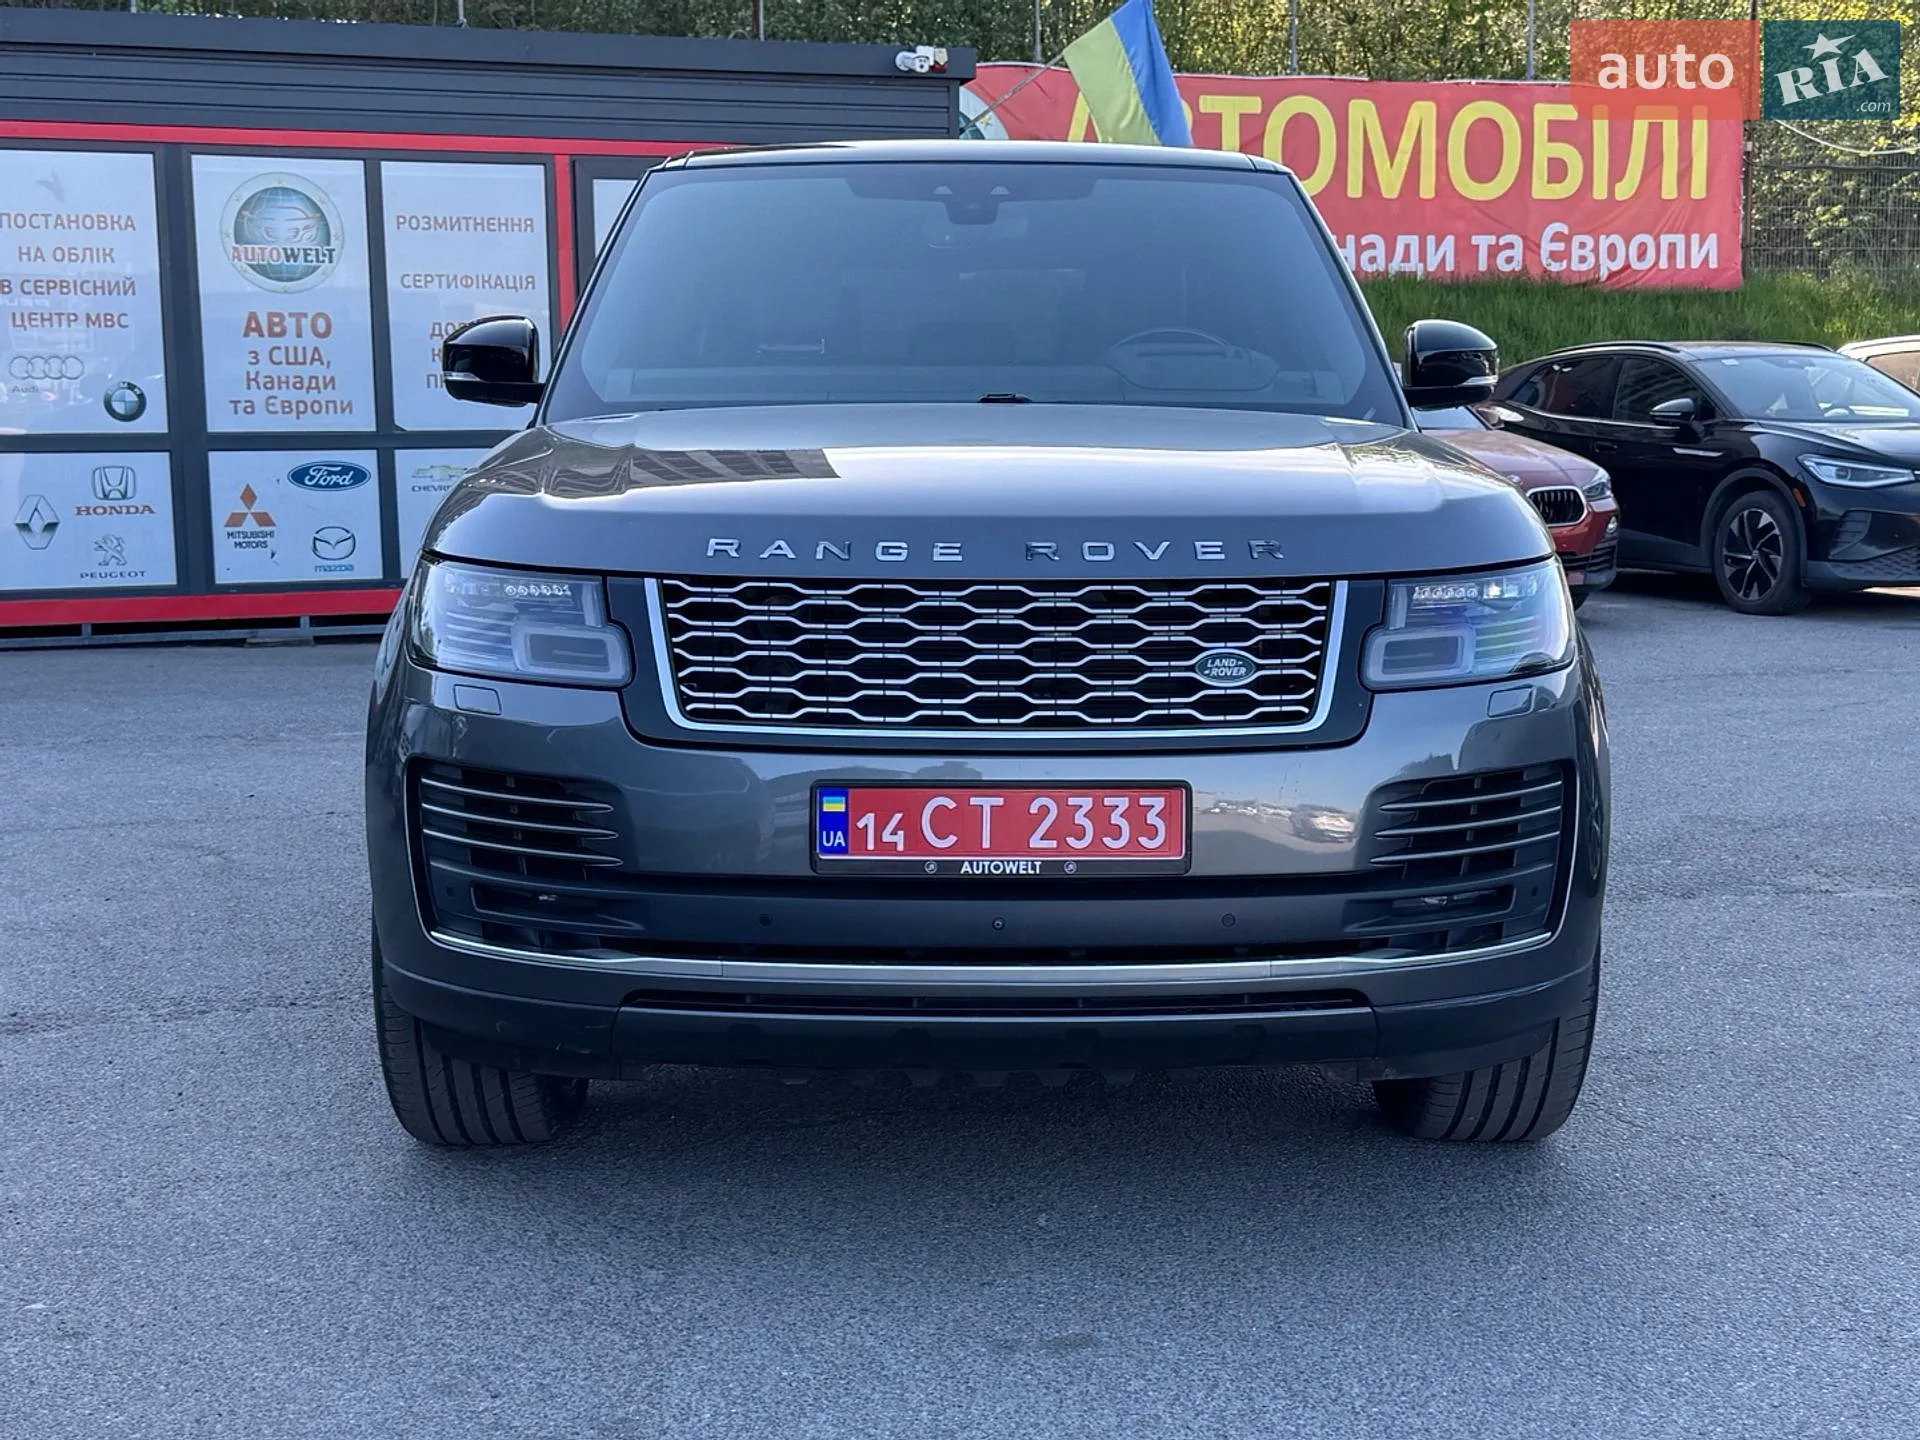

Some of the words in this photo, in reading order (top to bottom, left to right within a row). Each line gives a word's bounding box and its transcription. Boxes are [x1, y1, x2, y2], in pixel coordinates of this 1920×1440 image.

[1067, 93, 1708, 200] ТОМОБІЛІ
[0, 212, 136, 231] ПОСТАНОВКА
[395, 215, 535, 233] РОЗМИТНЕННЯ
[17, 245, 46, 262] НА
[52, 246, 115, 263] ОБЛІК
[231, 244, 336, 264] AUTOWELT
[1470, 233, 1523, 272] та
[1539, 221, 1719, 281] Європи
[0, 279, 13, 295] В
[20, 276, 136, 296] СЕРВІСНИЙ
[400, 273, 536, 291] СЕРТИФІКАЦІЯ
[11, 311, 79, 331] ЦЕНТР
[85, 312, 129, 329] МВС
[242, 311, 333, 339] АВТО
[248, 350, 260, 366] з
[268, 346, 331, 369] США,
[245, 370, 336, 394] Канади
[229, 400, 256, 416] та
[265, 395, 354, 420] Європи
[304, 465, 355, 486] Ford
[76, 504, 157, 516] HONDA
[226, 530, 275, 540] MITSUBISHI
[233, 540, 269, 549] MOTORS
[706, 537, 965, 563] RANGE
[1025, 538, 1285, 563] ROVER
[80, 570, 147, 579] PEUGEOT
[314, 564, 355, 573] mazda
[1206, 658, 1237, 668] LAND
[1209, 666, 1247, 677] ROVER
[856, 812, 905, 852] 14
[1027, 796, 1168, 850] 2333
[822, 831, 846, 847] UA
[960, 861, 1042, 875] AUTOWELT
